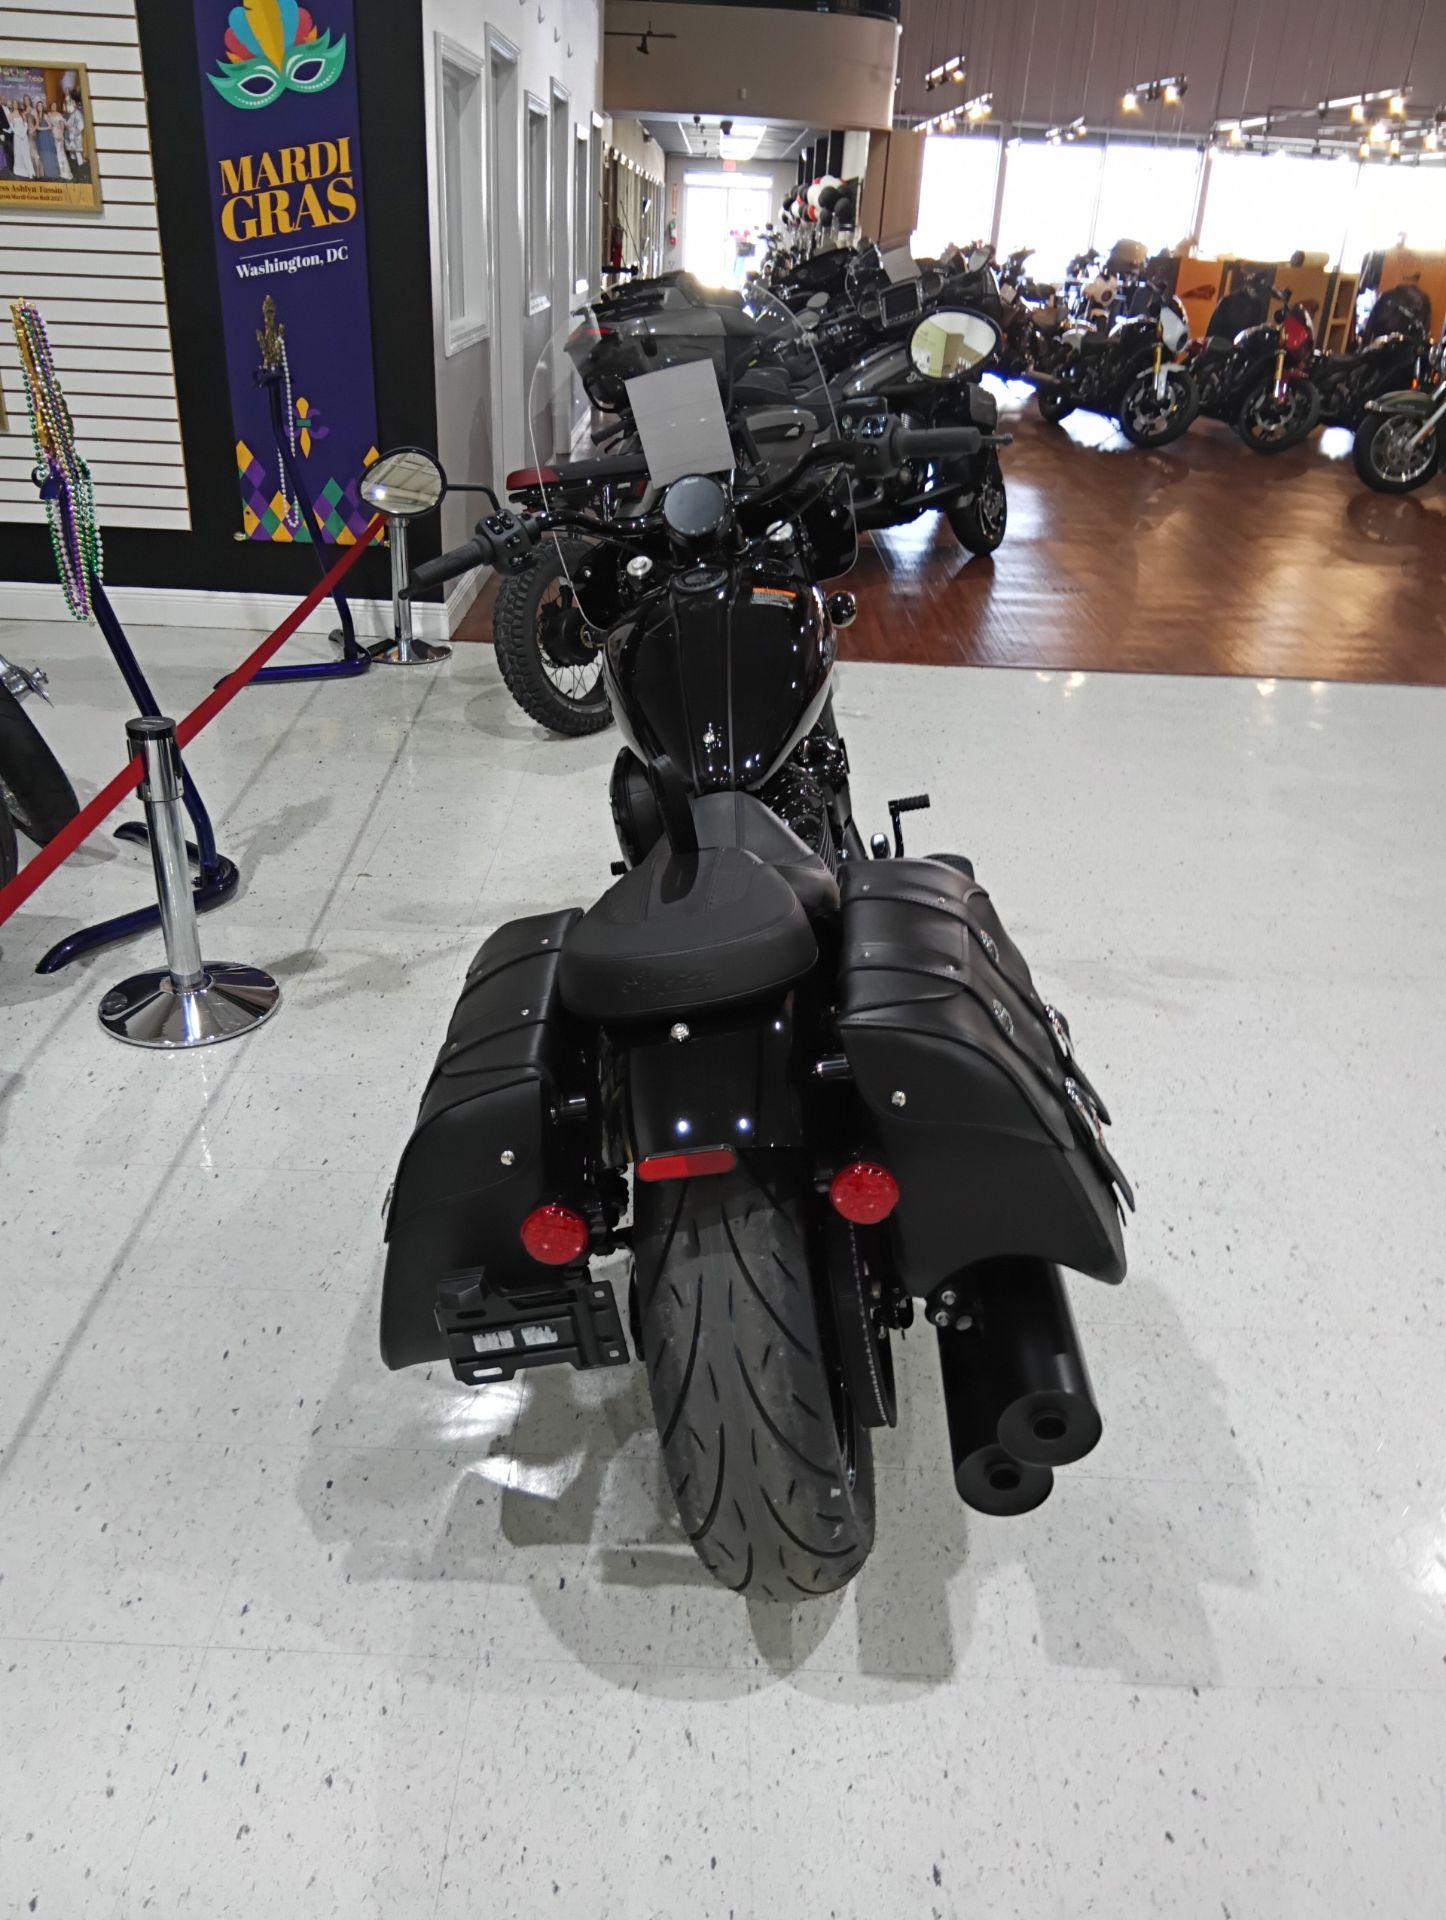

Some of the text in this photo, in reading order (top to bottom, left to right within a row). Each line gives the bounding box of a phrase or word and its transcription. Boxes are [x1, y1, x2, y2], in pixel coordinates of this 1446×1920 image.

[218, 137, 352, 196] MARDI
[221, 177, 357, 242] GRAS
[236, 246, 349, 279] Washington, DC
